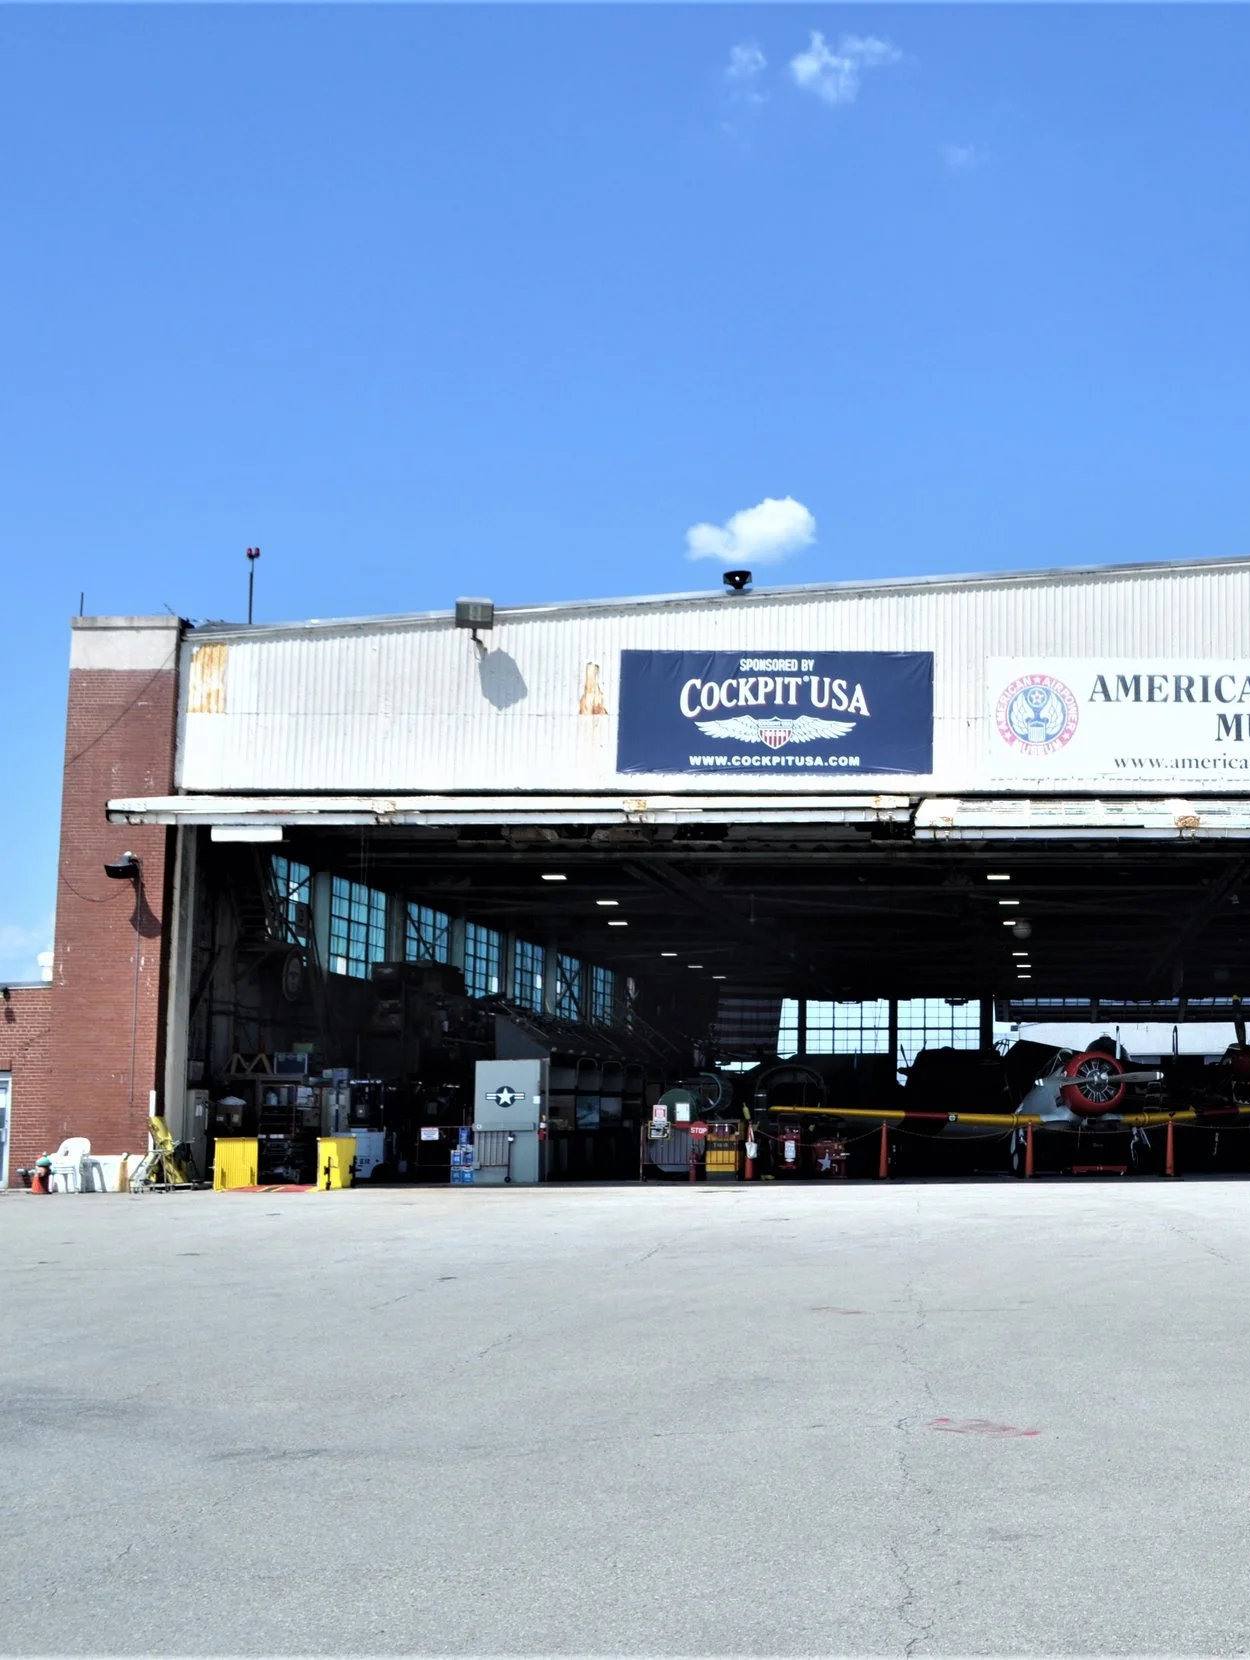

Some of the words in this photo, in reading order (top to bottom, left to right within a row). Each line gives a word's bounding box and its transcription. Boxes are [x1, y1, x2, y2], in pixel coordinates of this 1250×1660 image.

[740, 659, 798, 671] SPONSORED
[801, 659, 815, 671] BY
[679, 677, 802, 718] COCKPIT
[810, 676, 871, 717] USA
[689, 756, 860, 767] WWW.COCKPITUSA.COM
